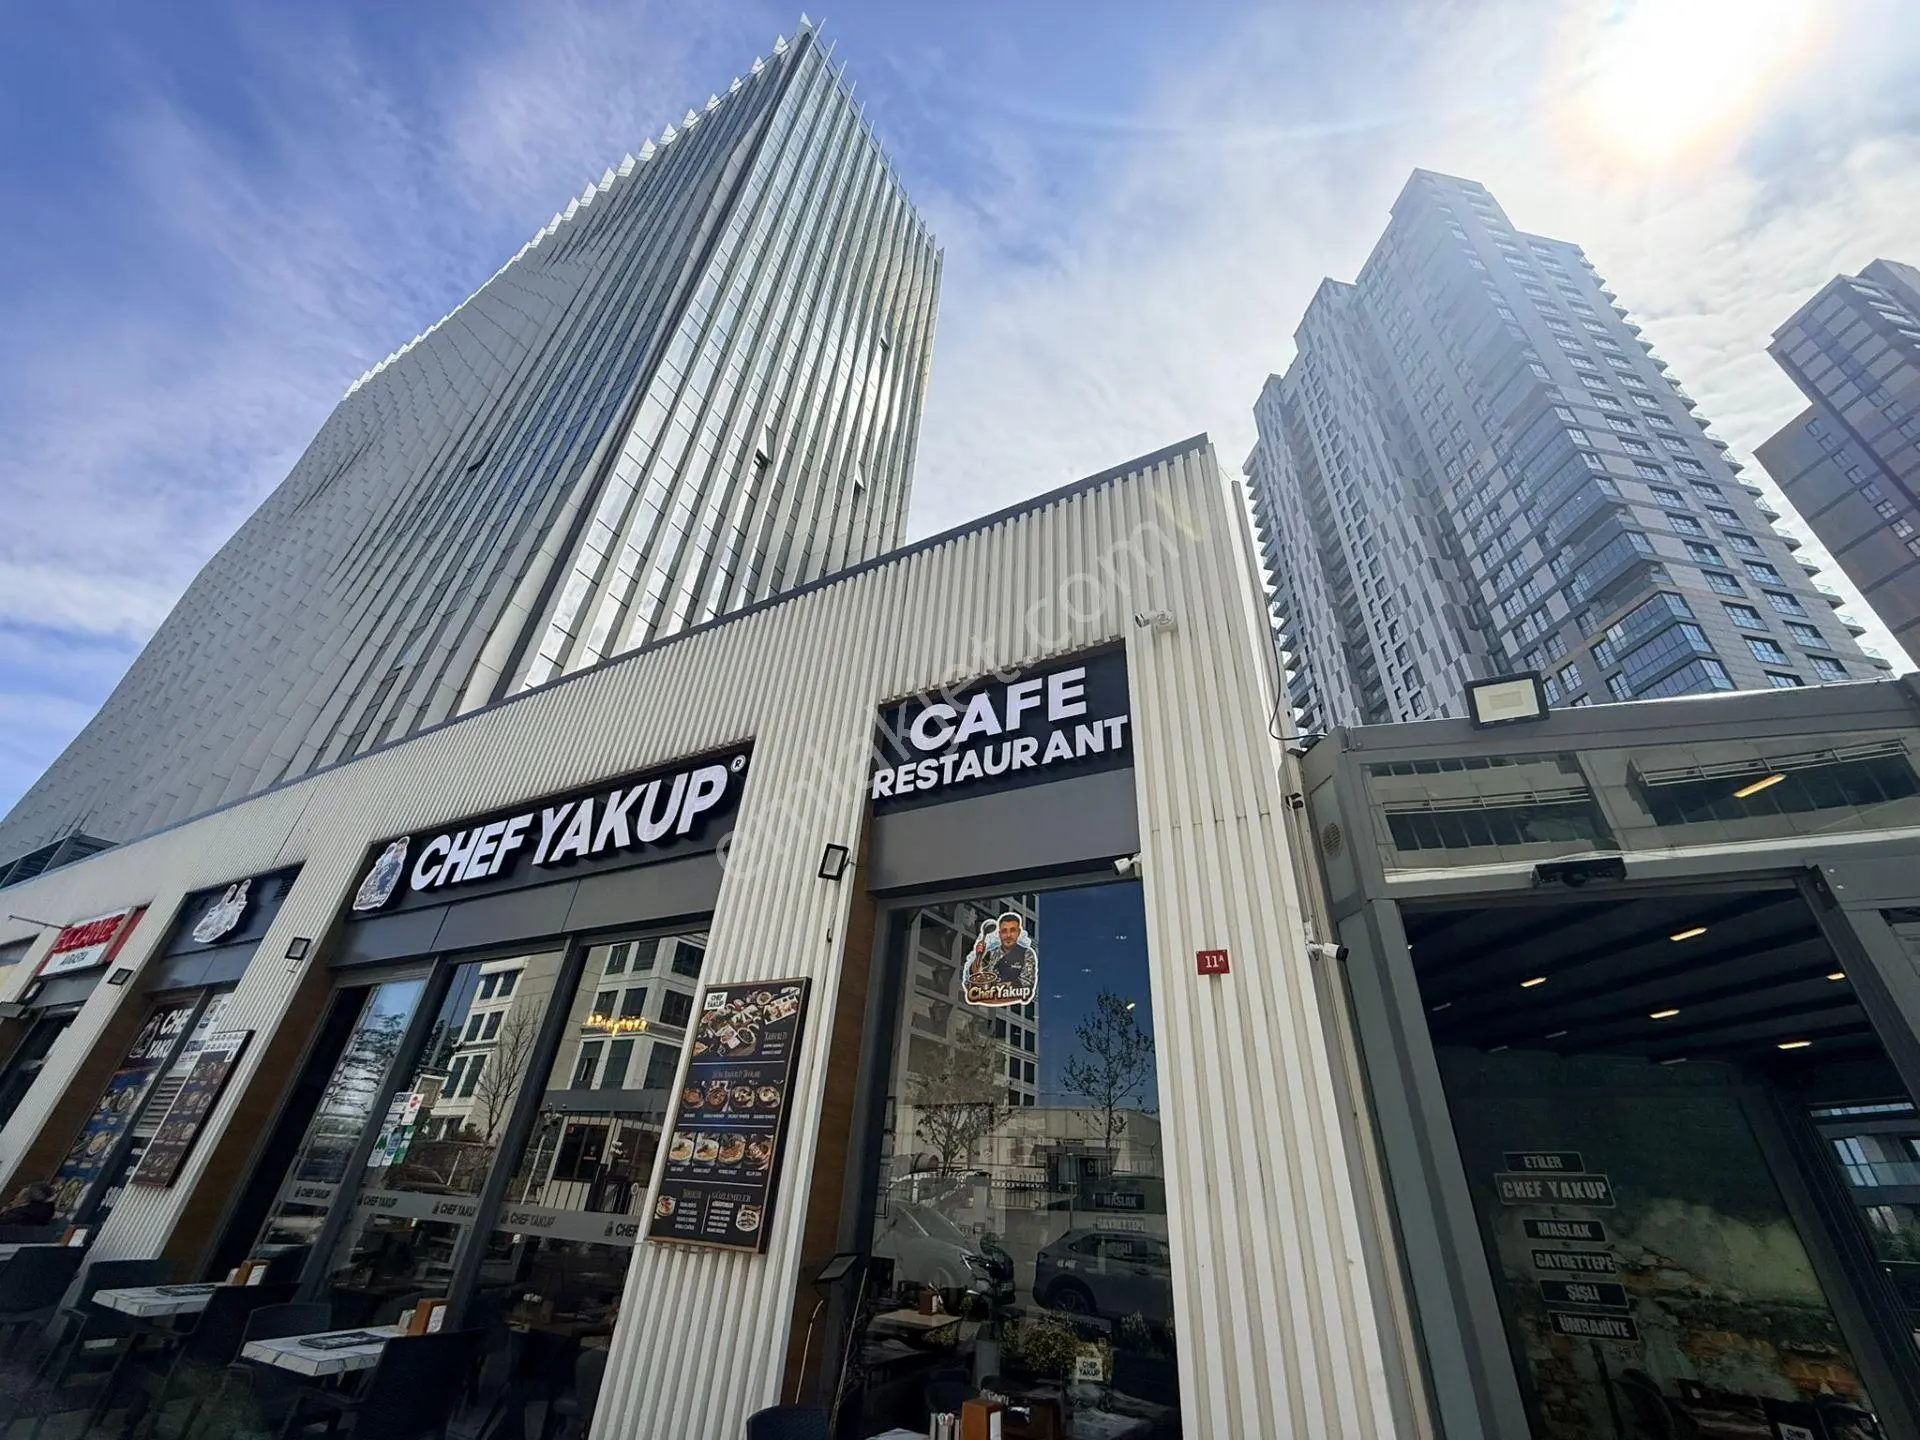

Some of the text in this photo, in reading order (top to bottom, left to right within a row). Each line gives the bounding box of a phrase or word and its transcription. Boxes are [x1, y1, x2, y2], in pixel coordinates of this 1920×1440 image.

[910, 667, 1087, 751] CAFE
[872, 715, 1128, 800] RESTAURANT
[411, 764, 729, 892] CHEF YAKUP
[968, 984, 1031, 1000] Chef Yakup
[160, 1009, 192, 1035] CHE
[145, 1038, 174, 1059] YAKU
[1502, 1180, 1608, 1200] CHEF YAKUP
[510, 1211, 531, 1224] CHEF
[1536, 1221, 1593, 1239] MASLAK
[1535, 1252, 1616, 1271] GAYRETTEPE
